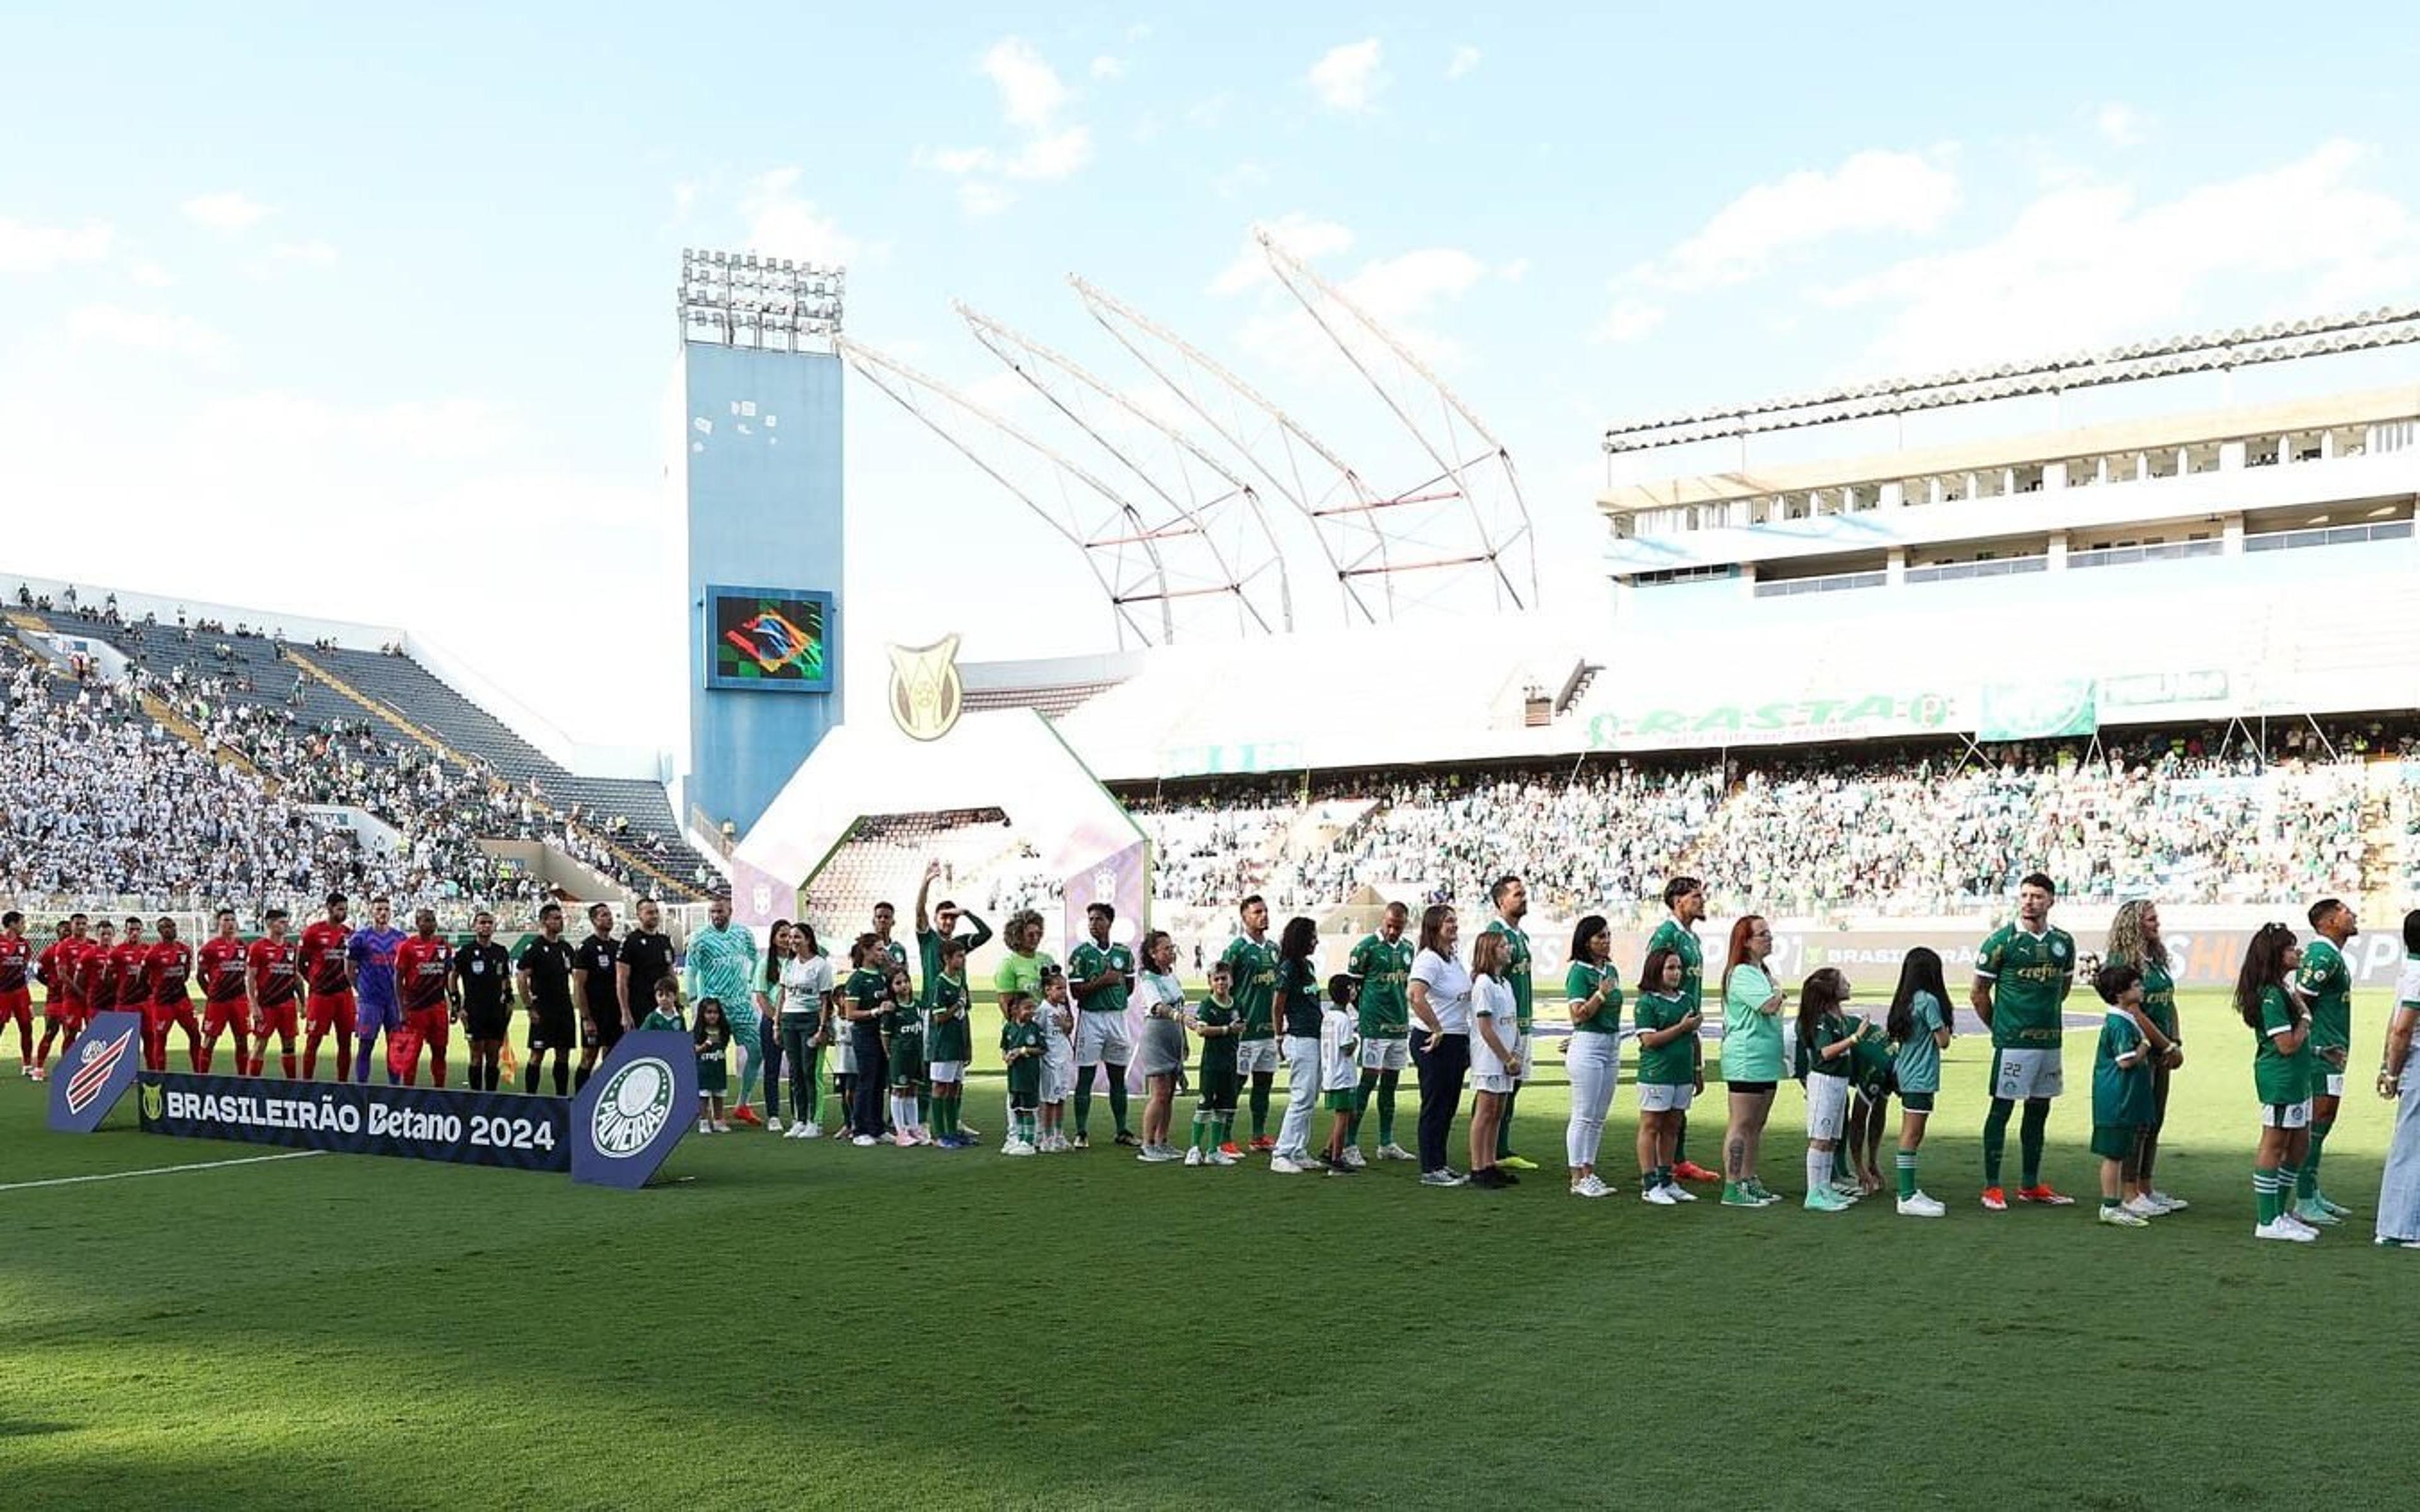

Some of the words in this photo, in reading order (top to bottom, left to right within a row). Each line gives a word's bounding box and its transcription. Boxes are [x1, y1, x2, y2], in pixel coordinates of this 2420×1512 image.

[2004, 1062, 2022, 1077] 22
[167, 1092, 360, 1133] BRASILEIRÃO
[369, 1103, 461, 1142] Betano
[470, 1115, 555, 1151] 2024
[597, 1101, 666, 1151] PALMEIRAS
